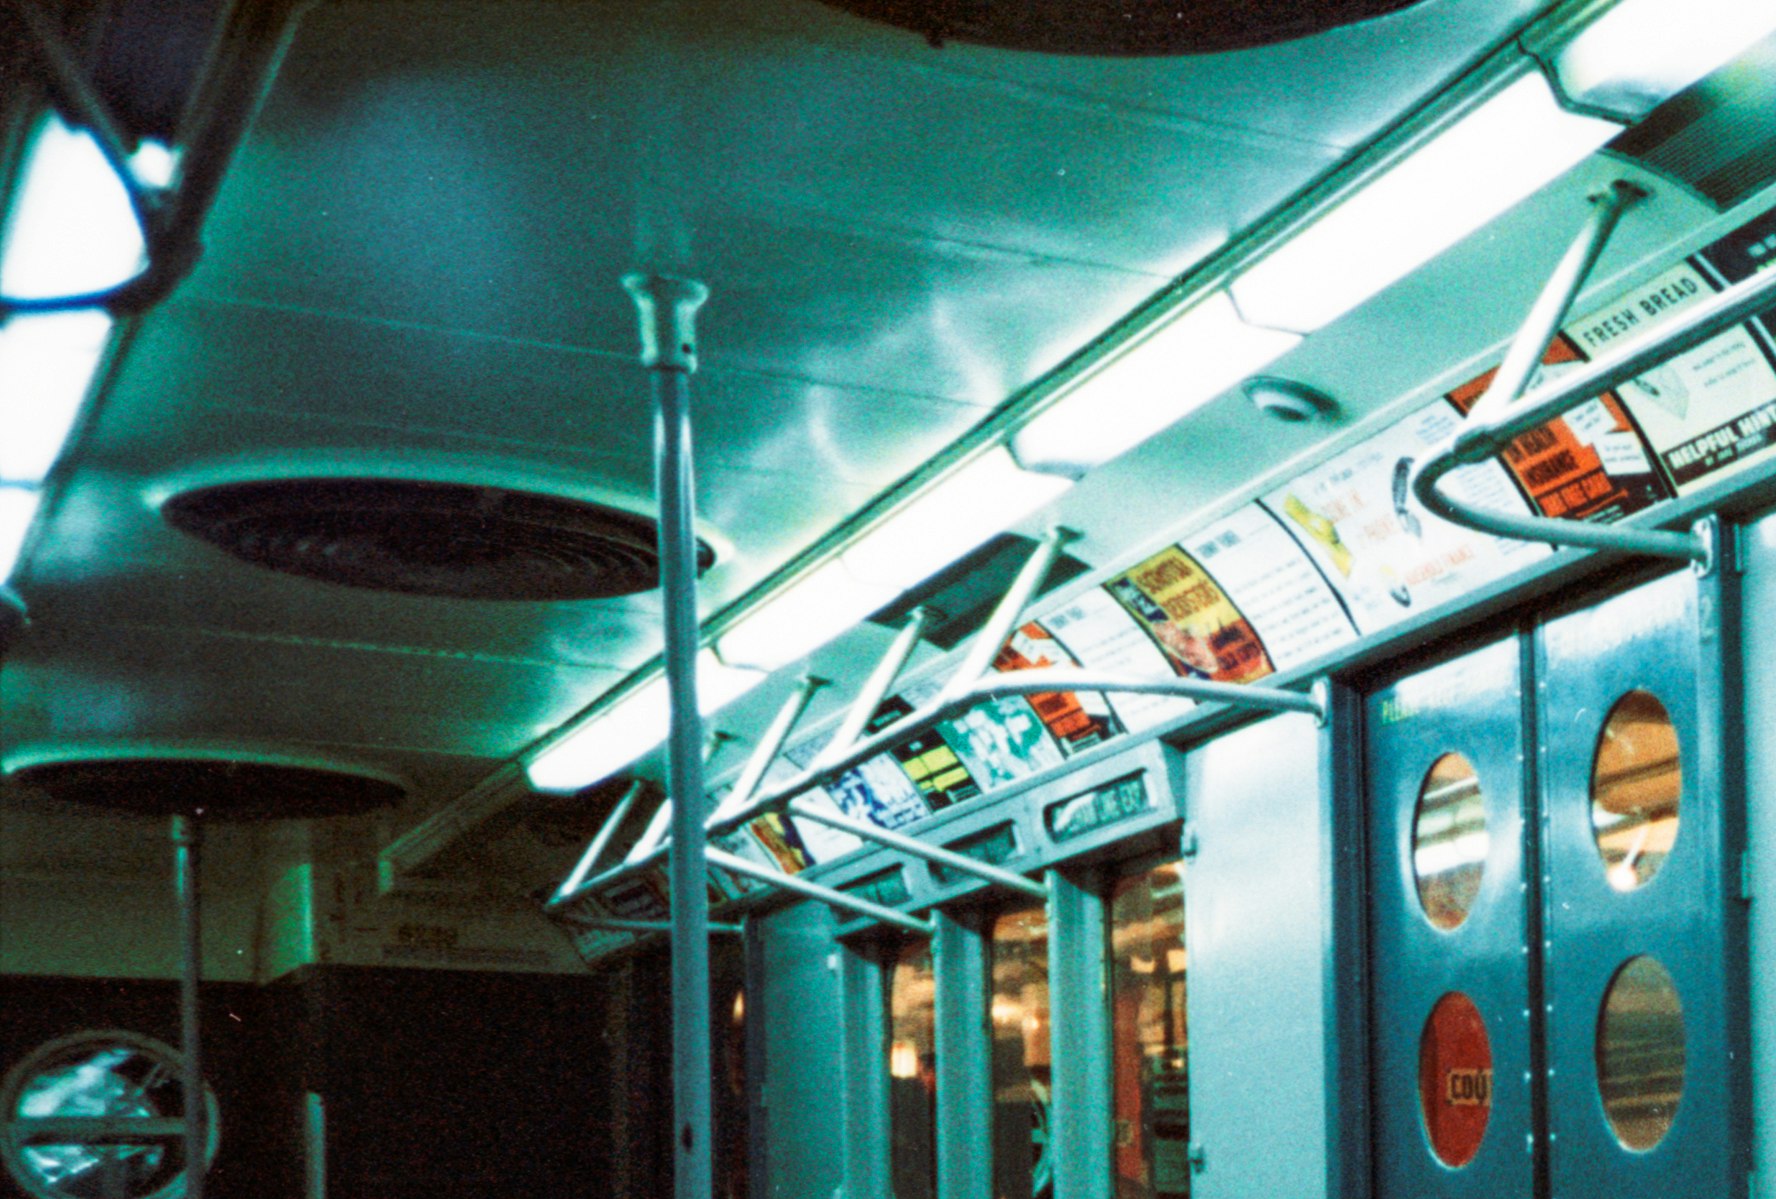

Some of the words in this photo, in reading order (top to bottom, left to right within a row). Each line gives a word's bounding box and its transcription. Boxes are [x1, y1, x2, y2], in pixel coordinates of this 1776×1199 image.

[1582, 308, 1641, 347] FRESH
[1639, 277, 1698, 316] BREAD
[1667, 425, 1740, 470] HELPFUL
[1451, 1073, 1491, 1099] COU
